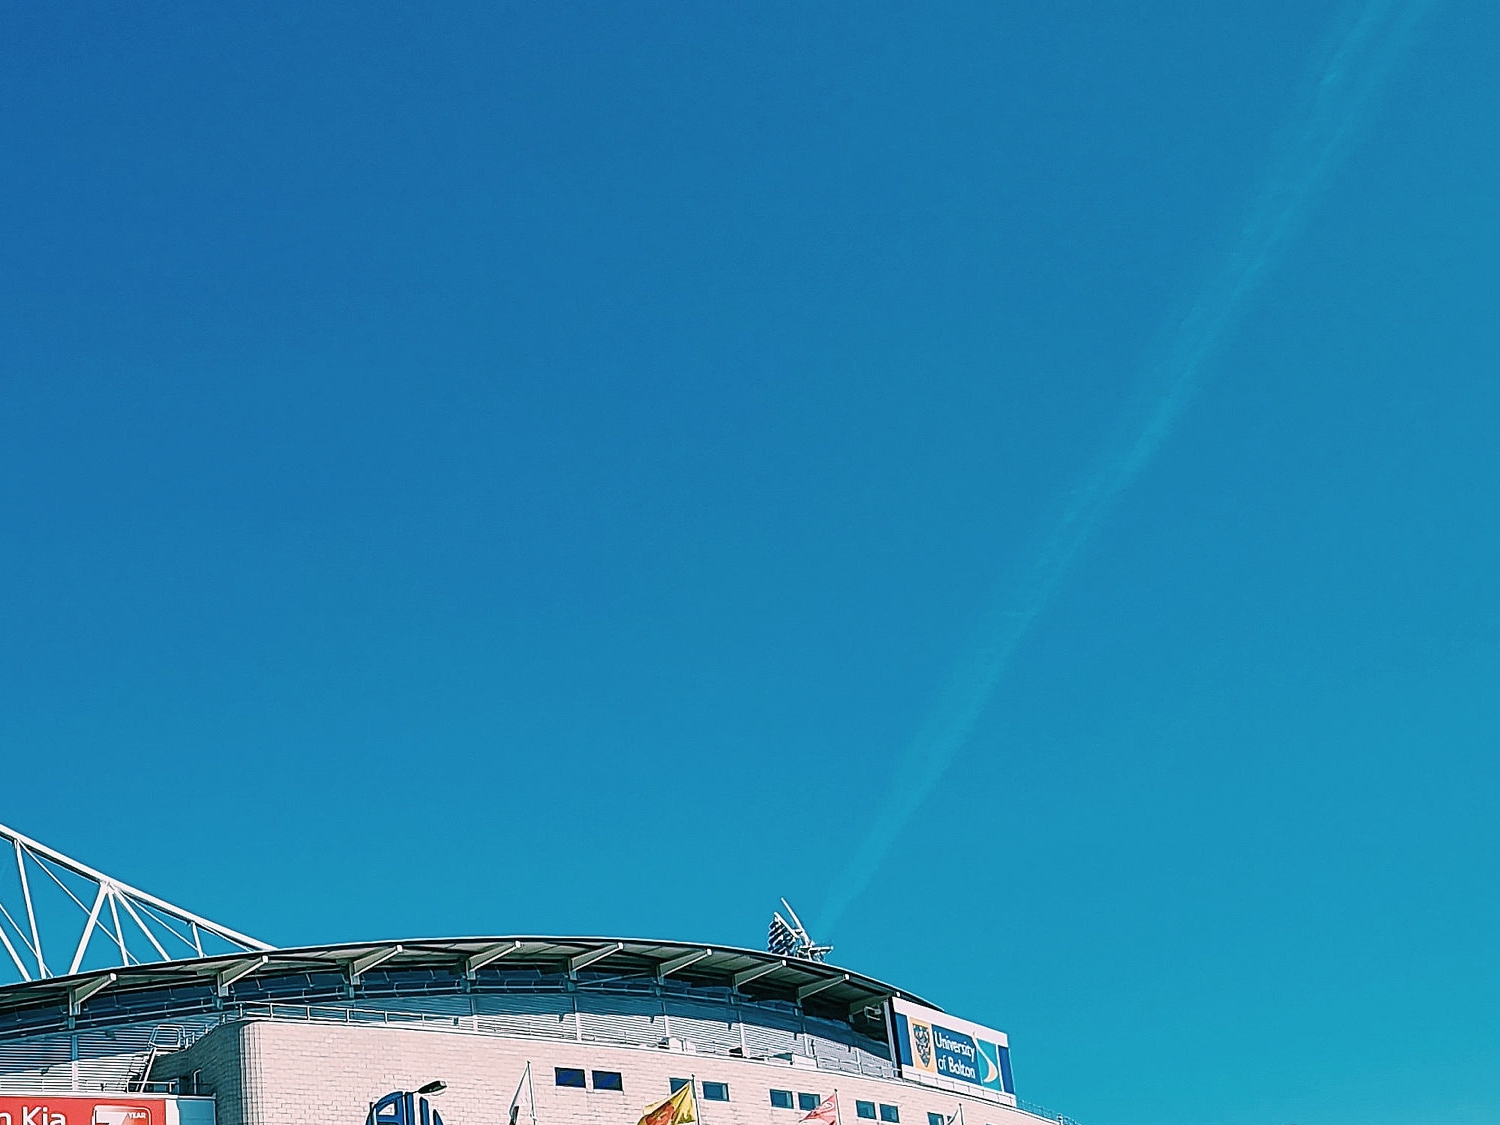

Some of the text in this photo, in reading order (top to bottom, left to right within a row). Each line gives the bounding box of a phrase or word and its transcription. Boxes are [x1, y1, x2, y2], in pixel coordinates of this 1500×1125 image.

[933, 1031, 975, 1062] University
[938, 1054, 976, 1079] of Bolton
